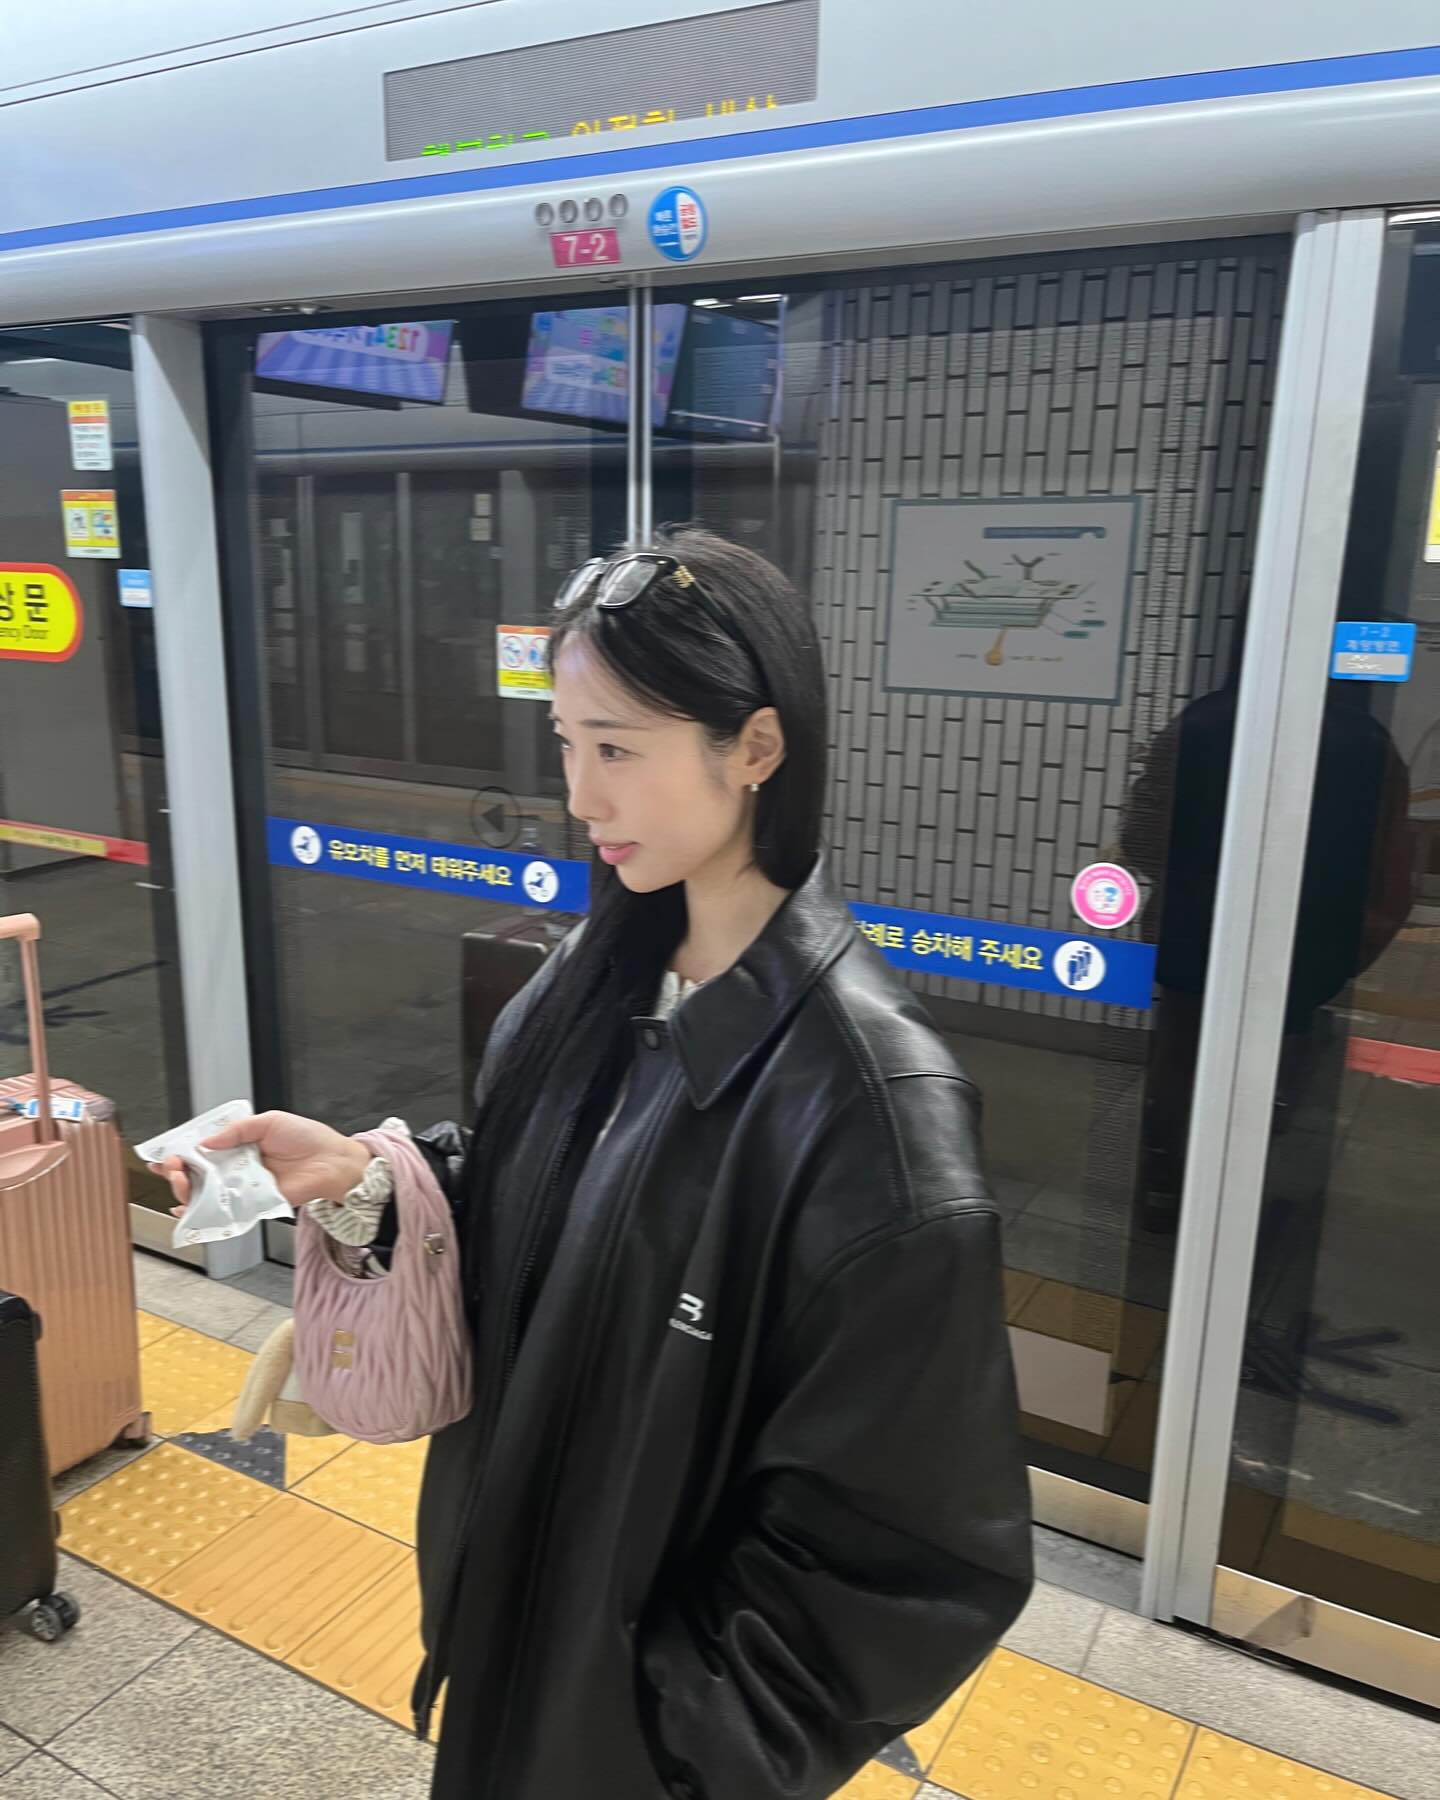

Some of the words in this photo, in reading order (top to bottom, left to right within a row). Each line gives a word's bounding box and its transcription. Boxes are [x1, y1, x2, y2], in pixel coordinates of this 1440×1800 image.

[561, 233, 611, 264] 7-2
[328, 839, 391, 869] 유모차를
[394, 850, 427, 875] 먼저
[431, 856, 514, 886] 태워주세요
[910, 928, 973, 962] 승차해
[976, 939, 1045, 970] 주세요
